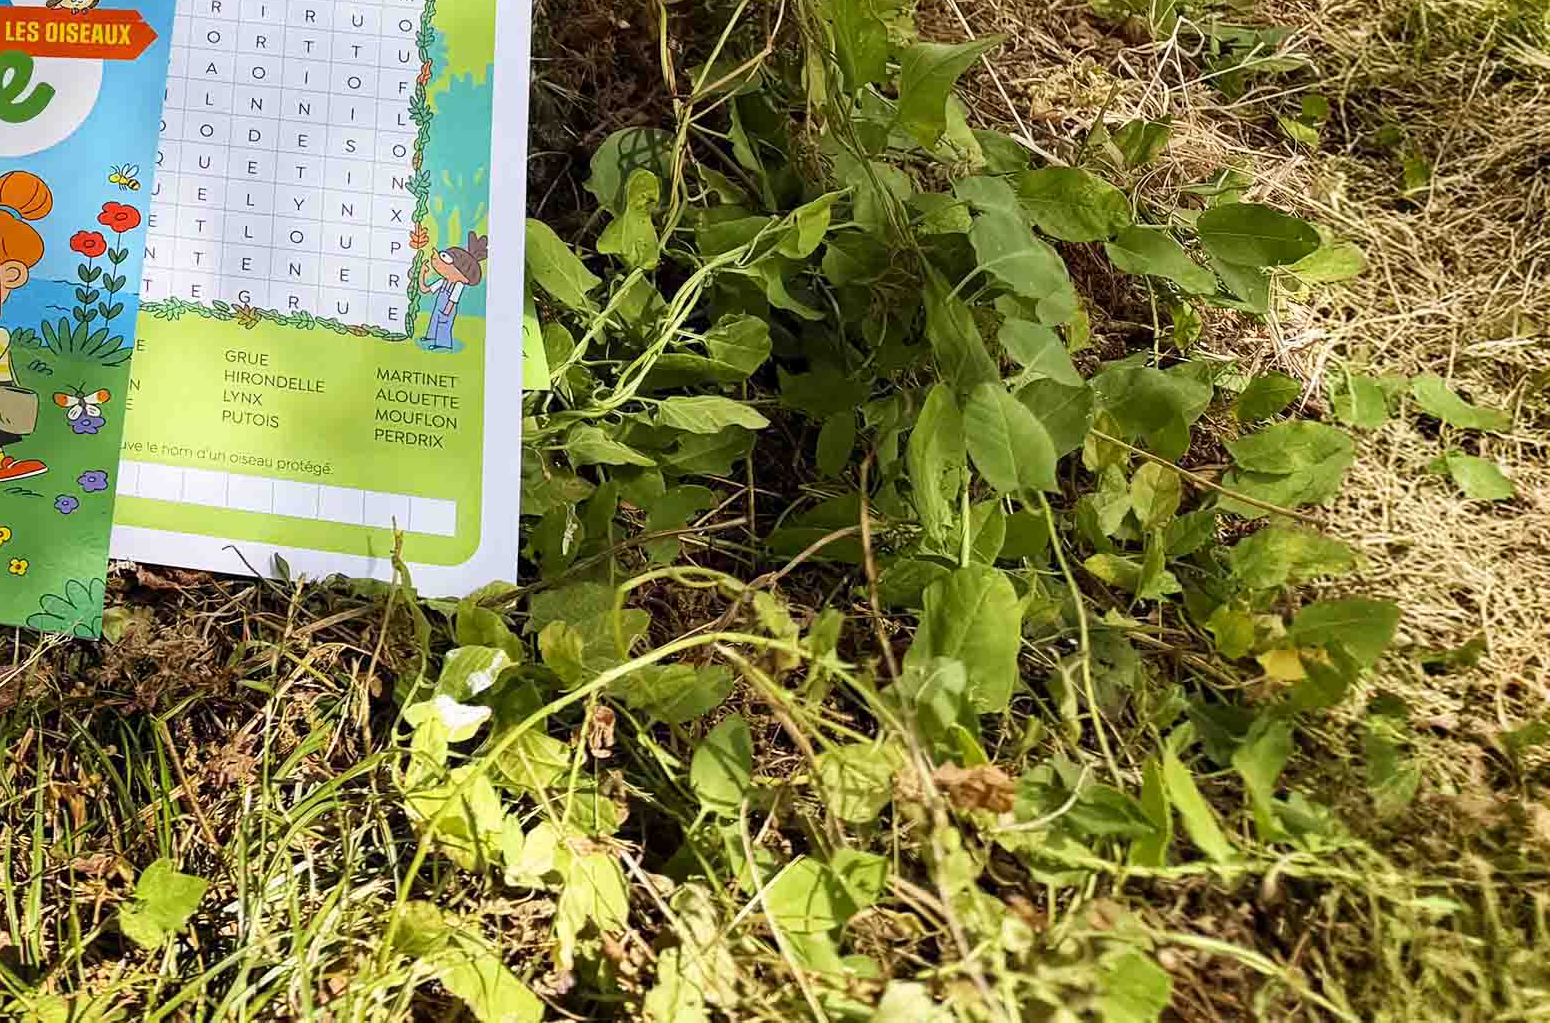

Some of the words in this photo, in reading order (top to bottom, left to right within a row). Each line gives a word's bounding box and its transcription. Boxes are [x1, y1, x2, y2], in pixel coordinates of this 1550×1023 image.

[211, 0, 222, 14] R
[304, 9, 316, 23] R
[351, 13, 364, 28] U
[398, 18, 413, 33] O
[5, 21, 39, 42] LES
[45, 21, 132, 45] OISEAUX
[206, 30, 221, 44] O
[255, 35, 267, 49] R
[302, 40, 315, 54] T
[350, 44, 362, 59] T
[398, 49, 411, 64] U
[205, 61, 218, 75] A
[251, 66, 267, 80] O
[346, 76, 362, 90] O
[398, 81, 409, 95] F
[205, 92, 214, 107] L
[250, 97, 263, 112] N
[298, 102, 311, 116] N
[397, 113, 407, 127] L
[199, 123, 214, 138] O
[248, 128, 262, 143] D
[297, 133, 309, 148] E
[345, 139, 357, 154] S
[392, 144, 407, 158] O
[198, 154, 211, 170] U
[247, 160, 258, 175] E
[295, 165, 307, 179] T
[391, 177, 404, 191] N
[197, 187, 207, 202] E
[246, 193, 255, 207] L
[293, 197, 305, 211] Y
[341, 202, 354, 217] N
[390, 209, 403, 223] X
[147, 214, 158, 228] E
[195, 219, 207, 233] T
[243, 225, 254, 239] L
[289, 230, 304, 244] O
[339, 234, 352, 250] U
[390, 241, 402, 255] P
[143, 246, 156, 259] N
[193, 251, 205, 266] T
[241, 257, 253, 272] E
[289, 262, 302, 277] N
[339, 267, 351, 283] E
[388, 273, 400, 289] R
[142, 278, 153, 292] T
[191, 284, 202, 299] E
[237, 289, 251, 304] G
[288, 295, 300, 310] R
[336, 300, 350, 315] U
[387, 305, 399, 322] E
[225, 349, 269, 367] GRUE
[223, 369, 326, 394] HIRONDELLE
[376, 367, 460, 388] MARTINET
[223, 389, 263, 407] LYNX
[375, 387, 461, 409] ALOUETTE
[221, 410, 280, 429] PUTOIS
[374, 408, 458, 430] MOUFLON
[374, 428, 444, 450] PERDRIX
[229, 452, 273, 468] oiseau
